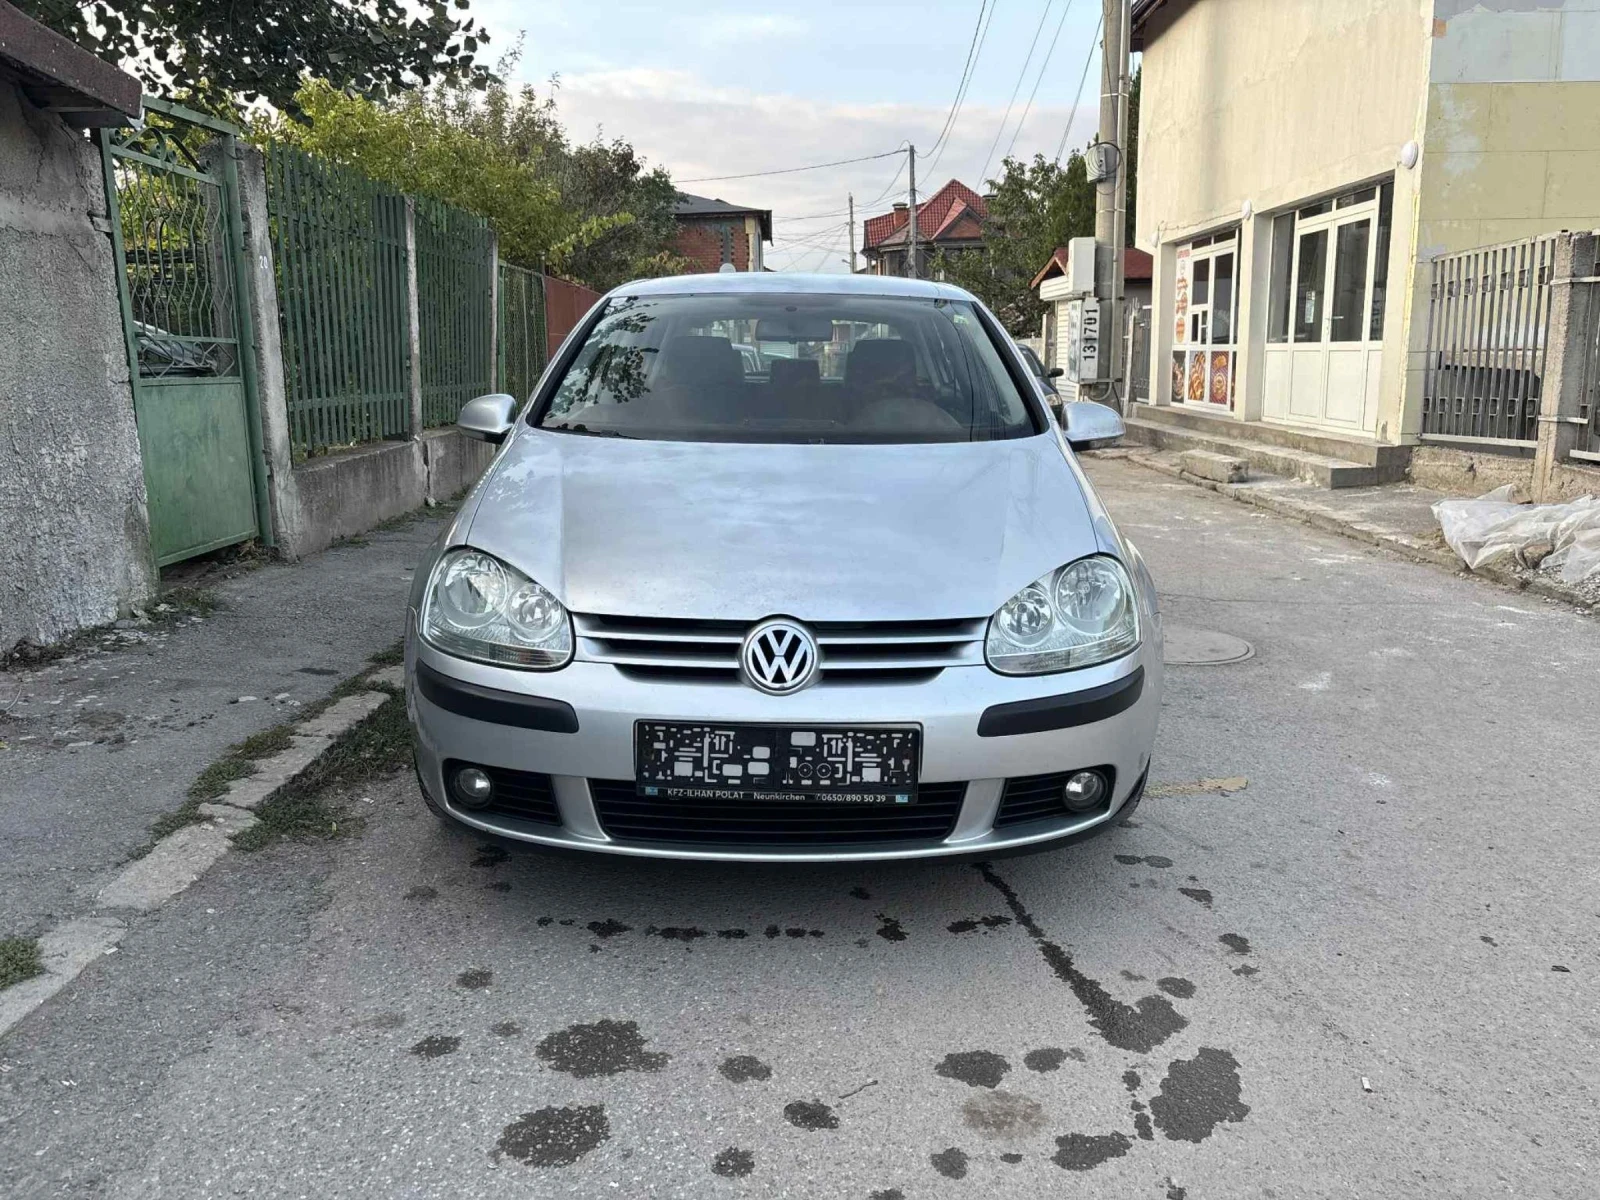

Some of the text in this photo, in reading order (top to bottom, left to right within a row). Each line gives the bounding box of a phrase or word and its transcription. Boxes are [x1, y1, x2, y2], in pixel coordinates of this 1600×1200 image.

[1082, 309, 1098, 361] 131701
[747, 624, 813, 689] VW
[667, 788, 714, 798] KFZ-ILHAN
[715, 790, 744, 799] POLAT
[753, 792, 806, 801] Neunkirchen
[821, 794, 862, 802] 0650/890
[863, 795, 874, 803] 50
[876, 795, 886, 803] 39
